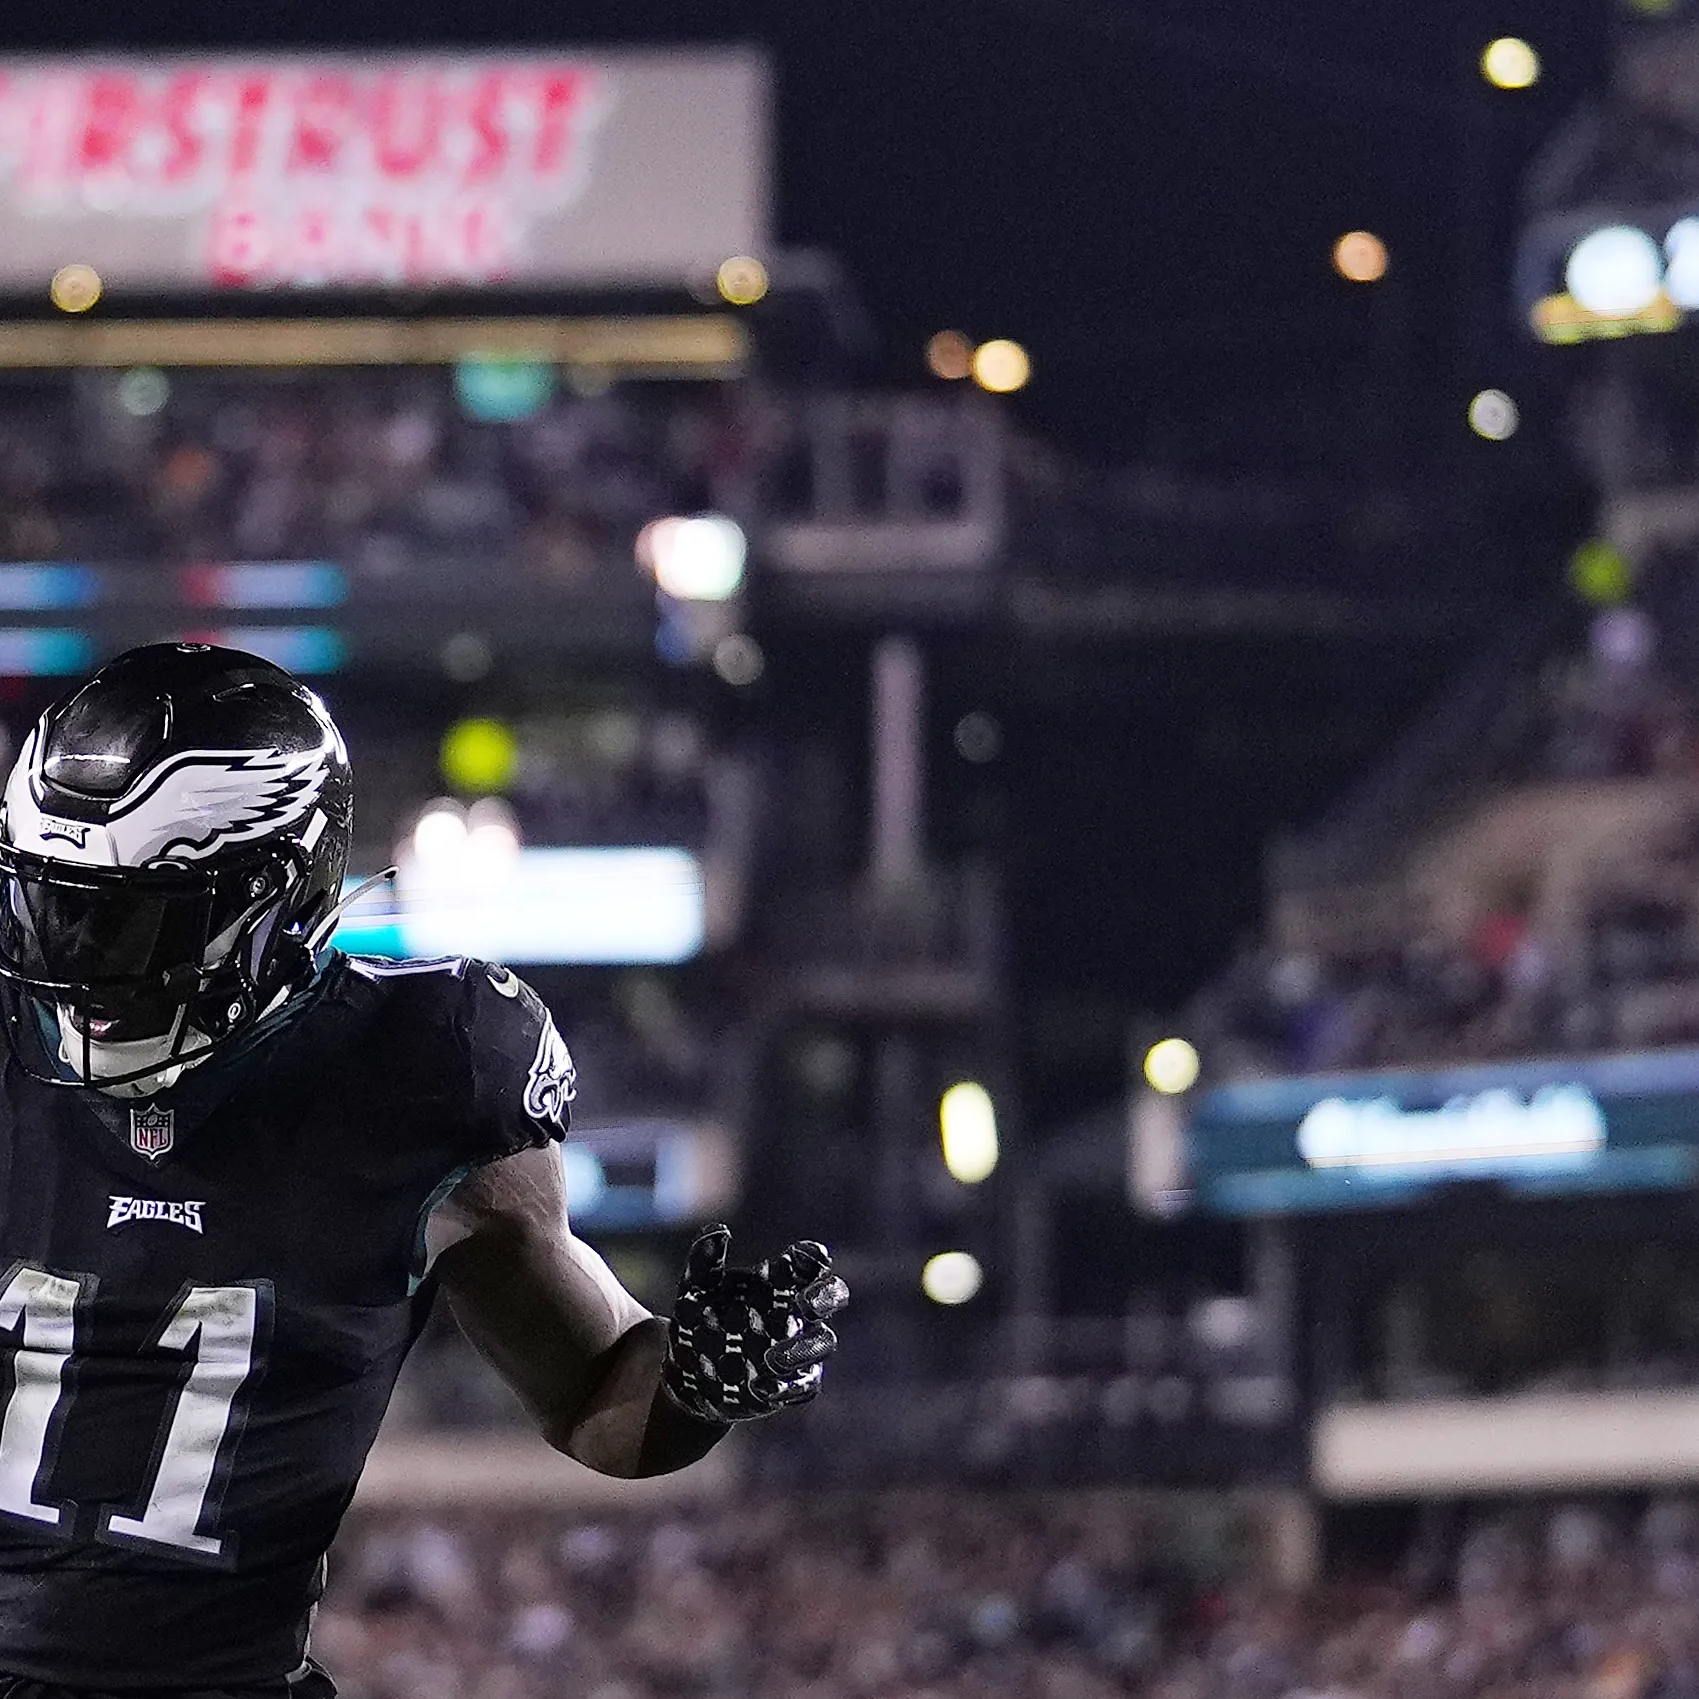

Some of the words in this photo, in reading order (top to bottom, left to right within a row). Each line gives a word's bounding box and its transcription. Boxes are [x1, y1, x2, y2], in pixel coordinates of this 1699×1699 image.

[205, 202, 518, 290] BANK
[137, 1126, 168, 1149] NFL
[106, 1194, 208, 1236] EAGLES
